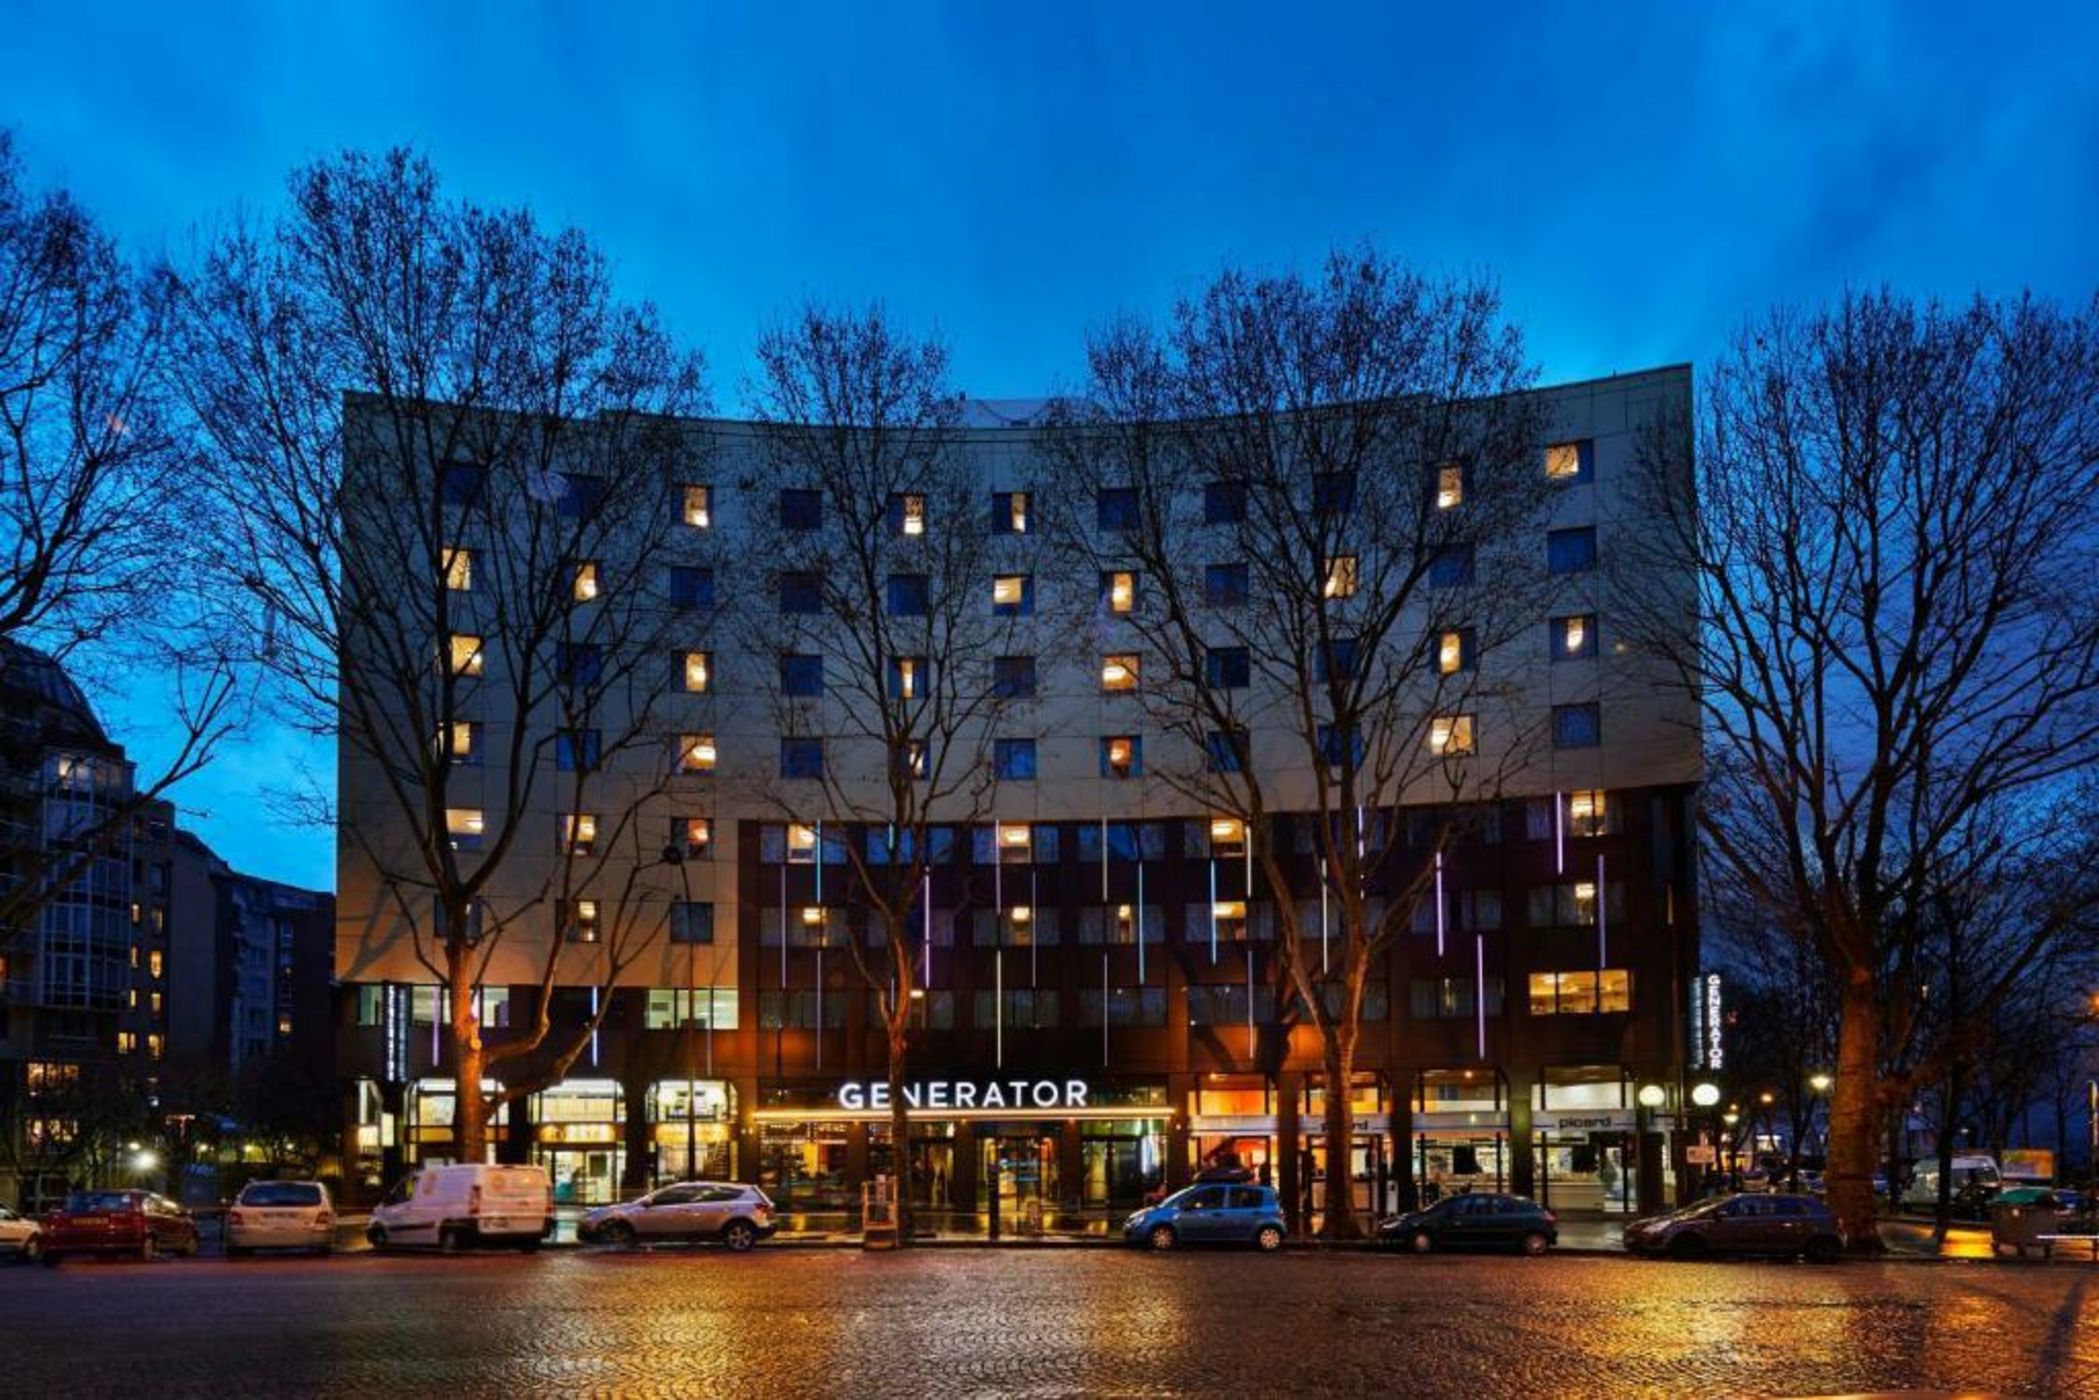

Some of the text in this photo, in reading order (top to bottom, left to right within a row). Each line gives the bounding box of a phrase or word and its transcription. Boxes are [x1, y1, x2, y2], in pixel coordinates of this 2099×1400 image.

[1707, 974, 1723, 1069] GENERATOR
[837, 1080, 1088, 1109] GENERATOR
[1559, 1116, 1612, 1129] picard
